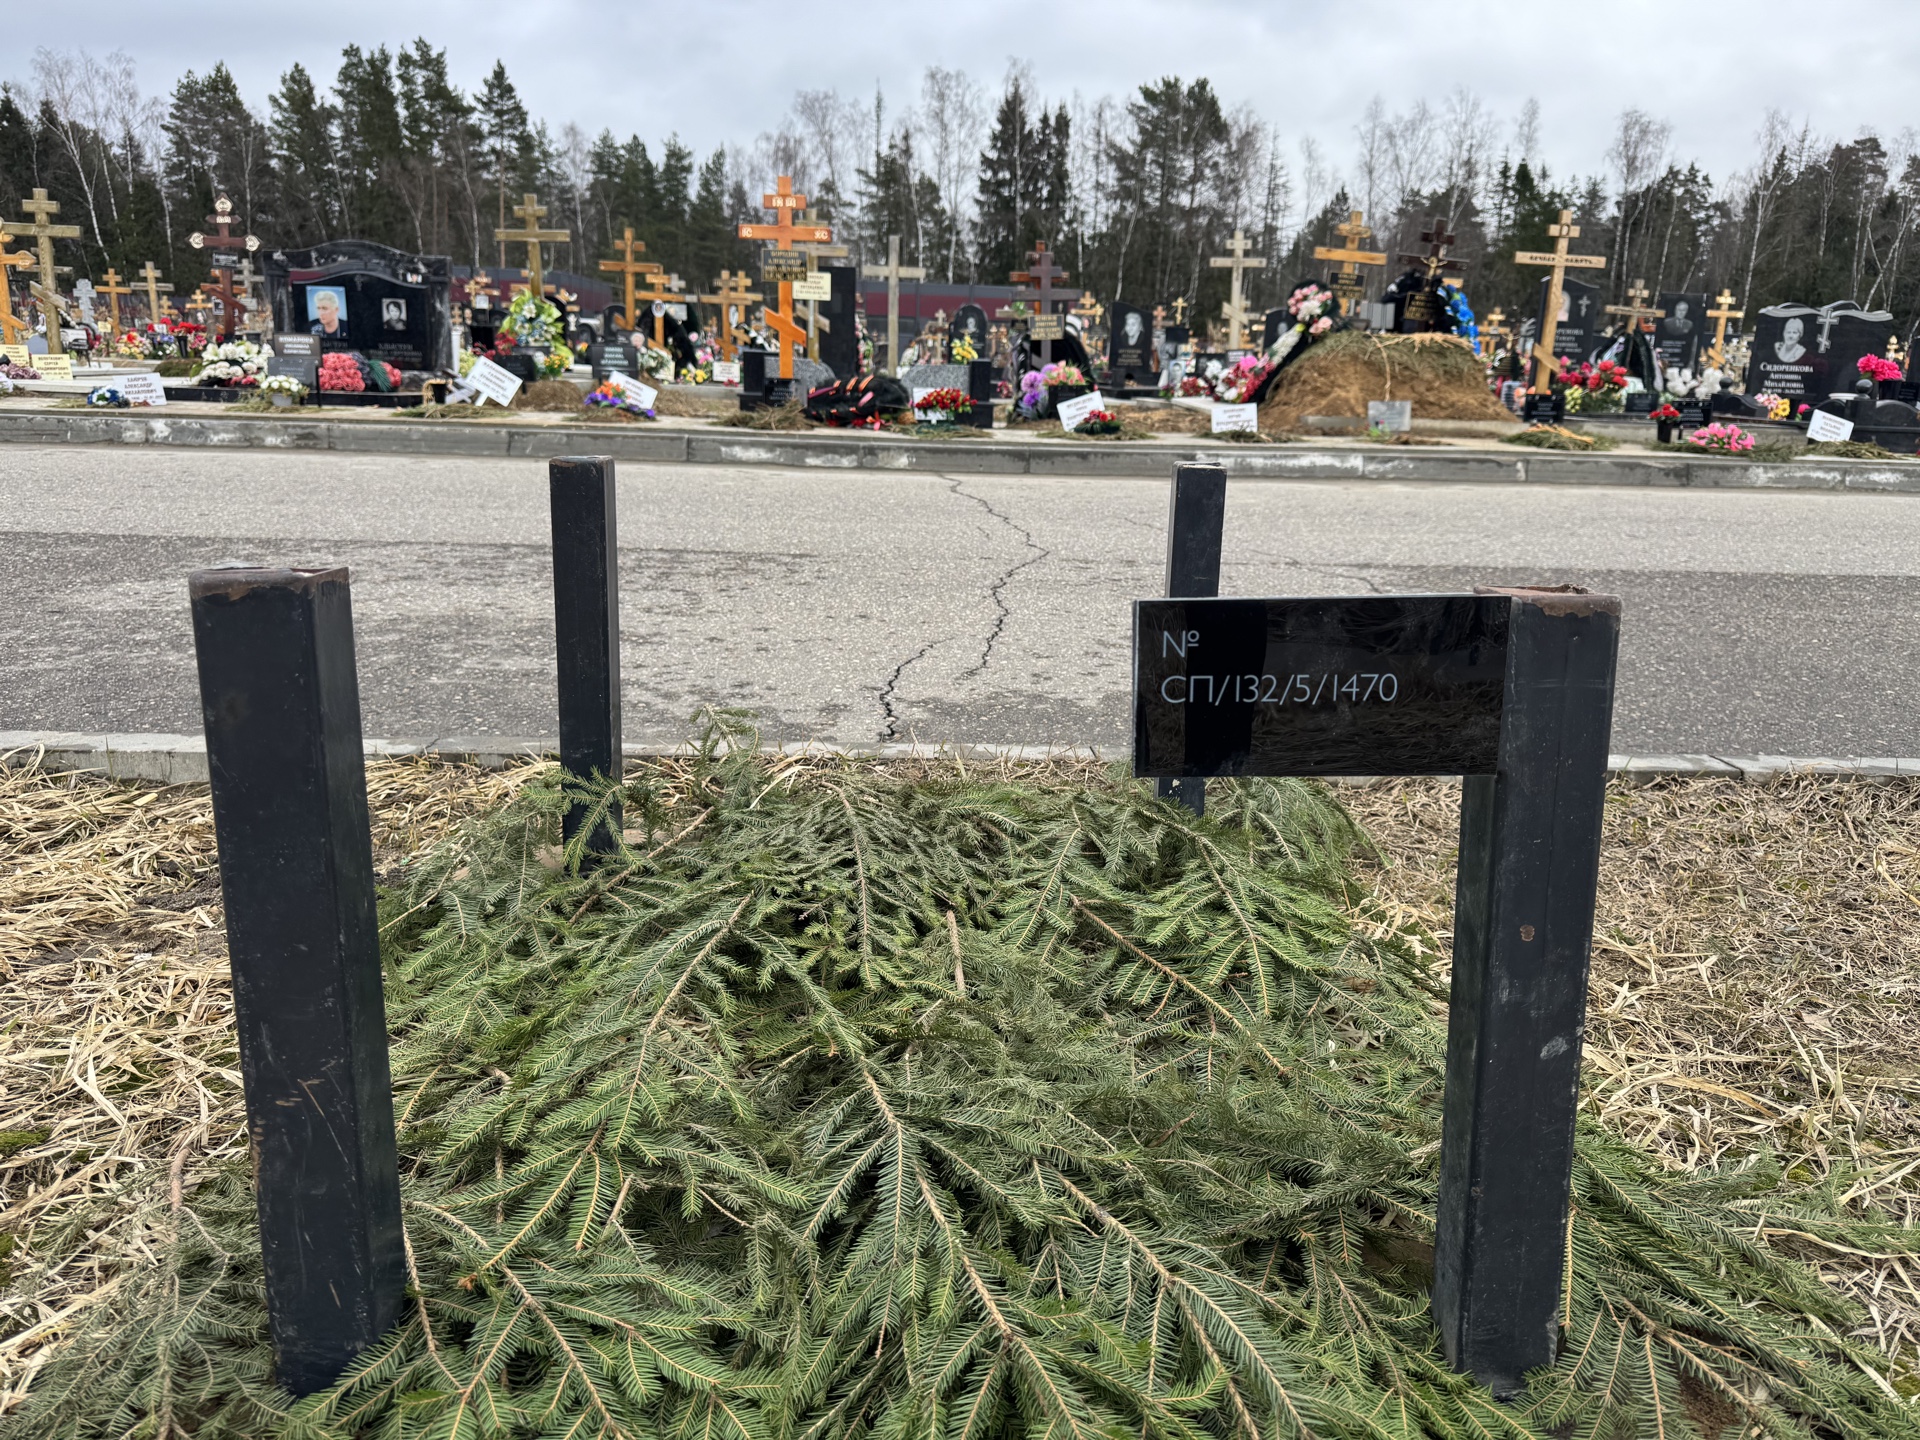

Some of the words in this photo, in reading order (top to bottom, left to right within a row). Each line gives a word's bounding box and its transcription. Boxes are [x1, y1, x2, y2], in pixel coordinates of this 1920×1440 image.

[1760, 361, 1814, 373] СИДОРЕНКОВА
[1769, 372, 1802, 380] АНТОНИНА
[1763, 380, 1804, 389] МИХАЙЛОВНА
[1163, 630, 1200, 658] №
[1161, 673, 1398, 706] СП/132/5/1470
